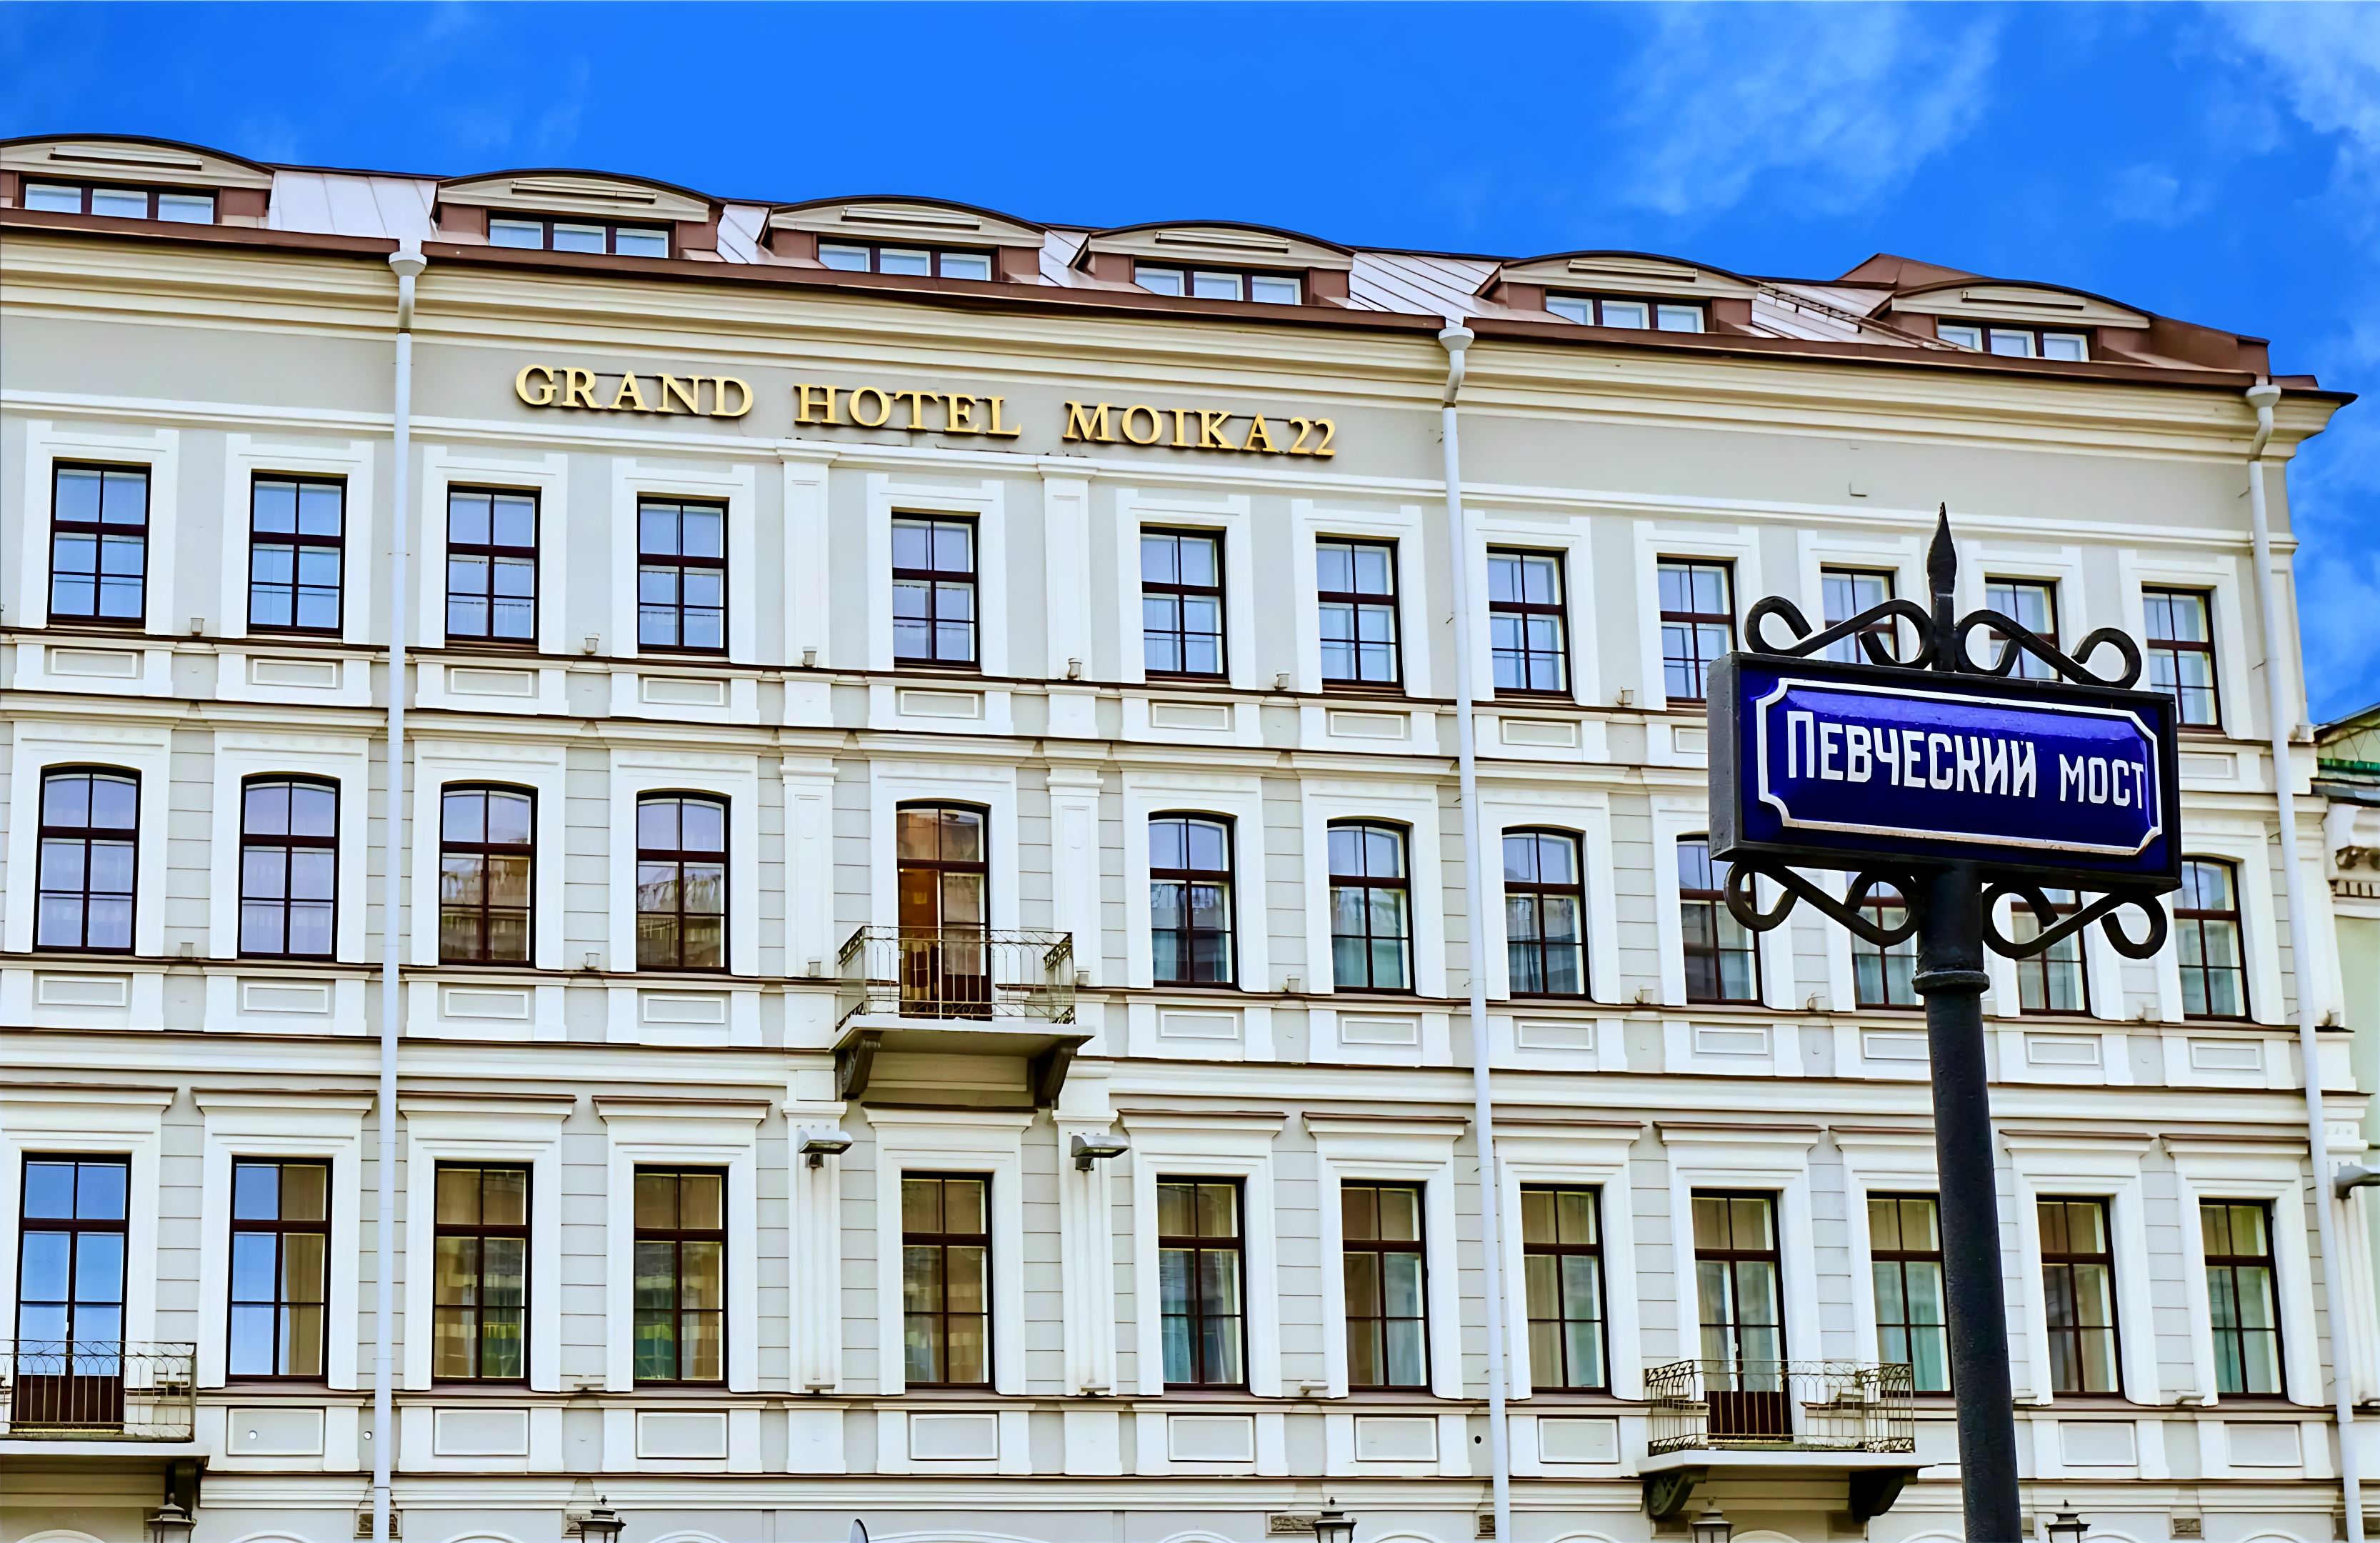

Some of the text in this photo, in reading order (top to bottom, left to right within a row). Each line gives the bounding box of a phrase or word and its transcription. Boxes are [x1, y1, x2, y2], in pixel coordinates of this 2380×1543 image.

[515, 364, 754, 417] GRAND
[794, 383, 1021, 437] HOTEL
[1786, 710, 2145, 809] ПЕВЧЕСКИЙ МОСТ
